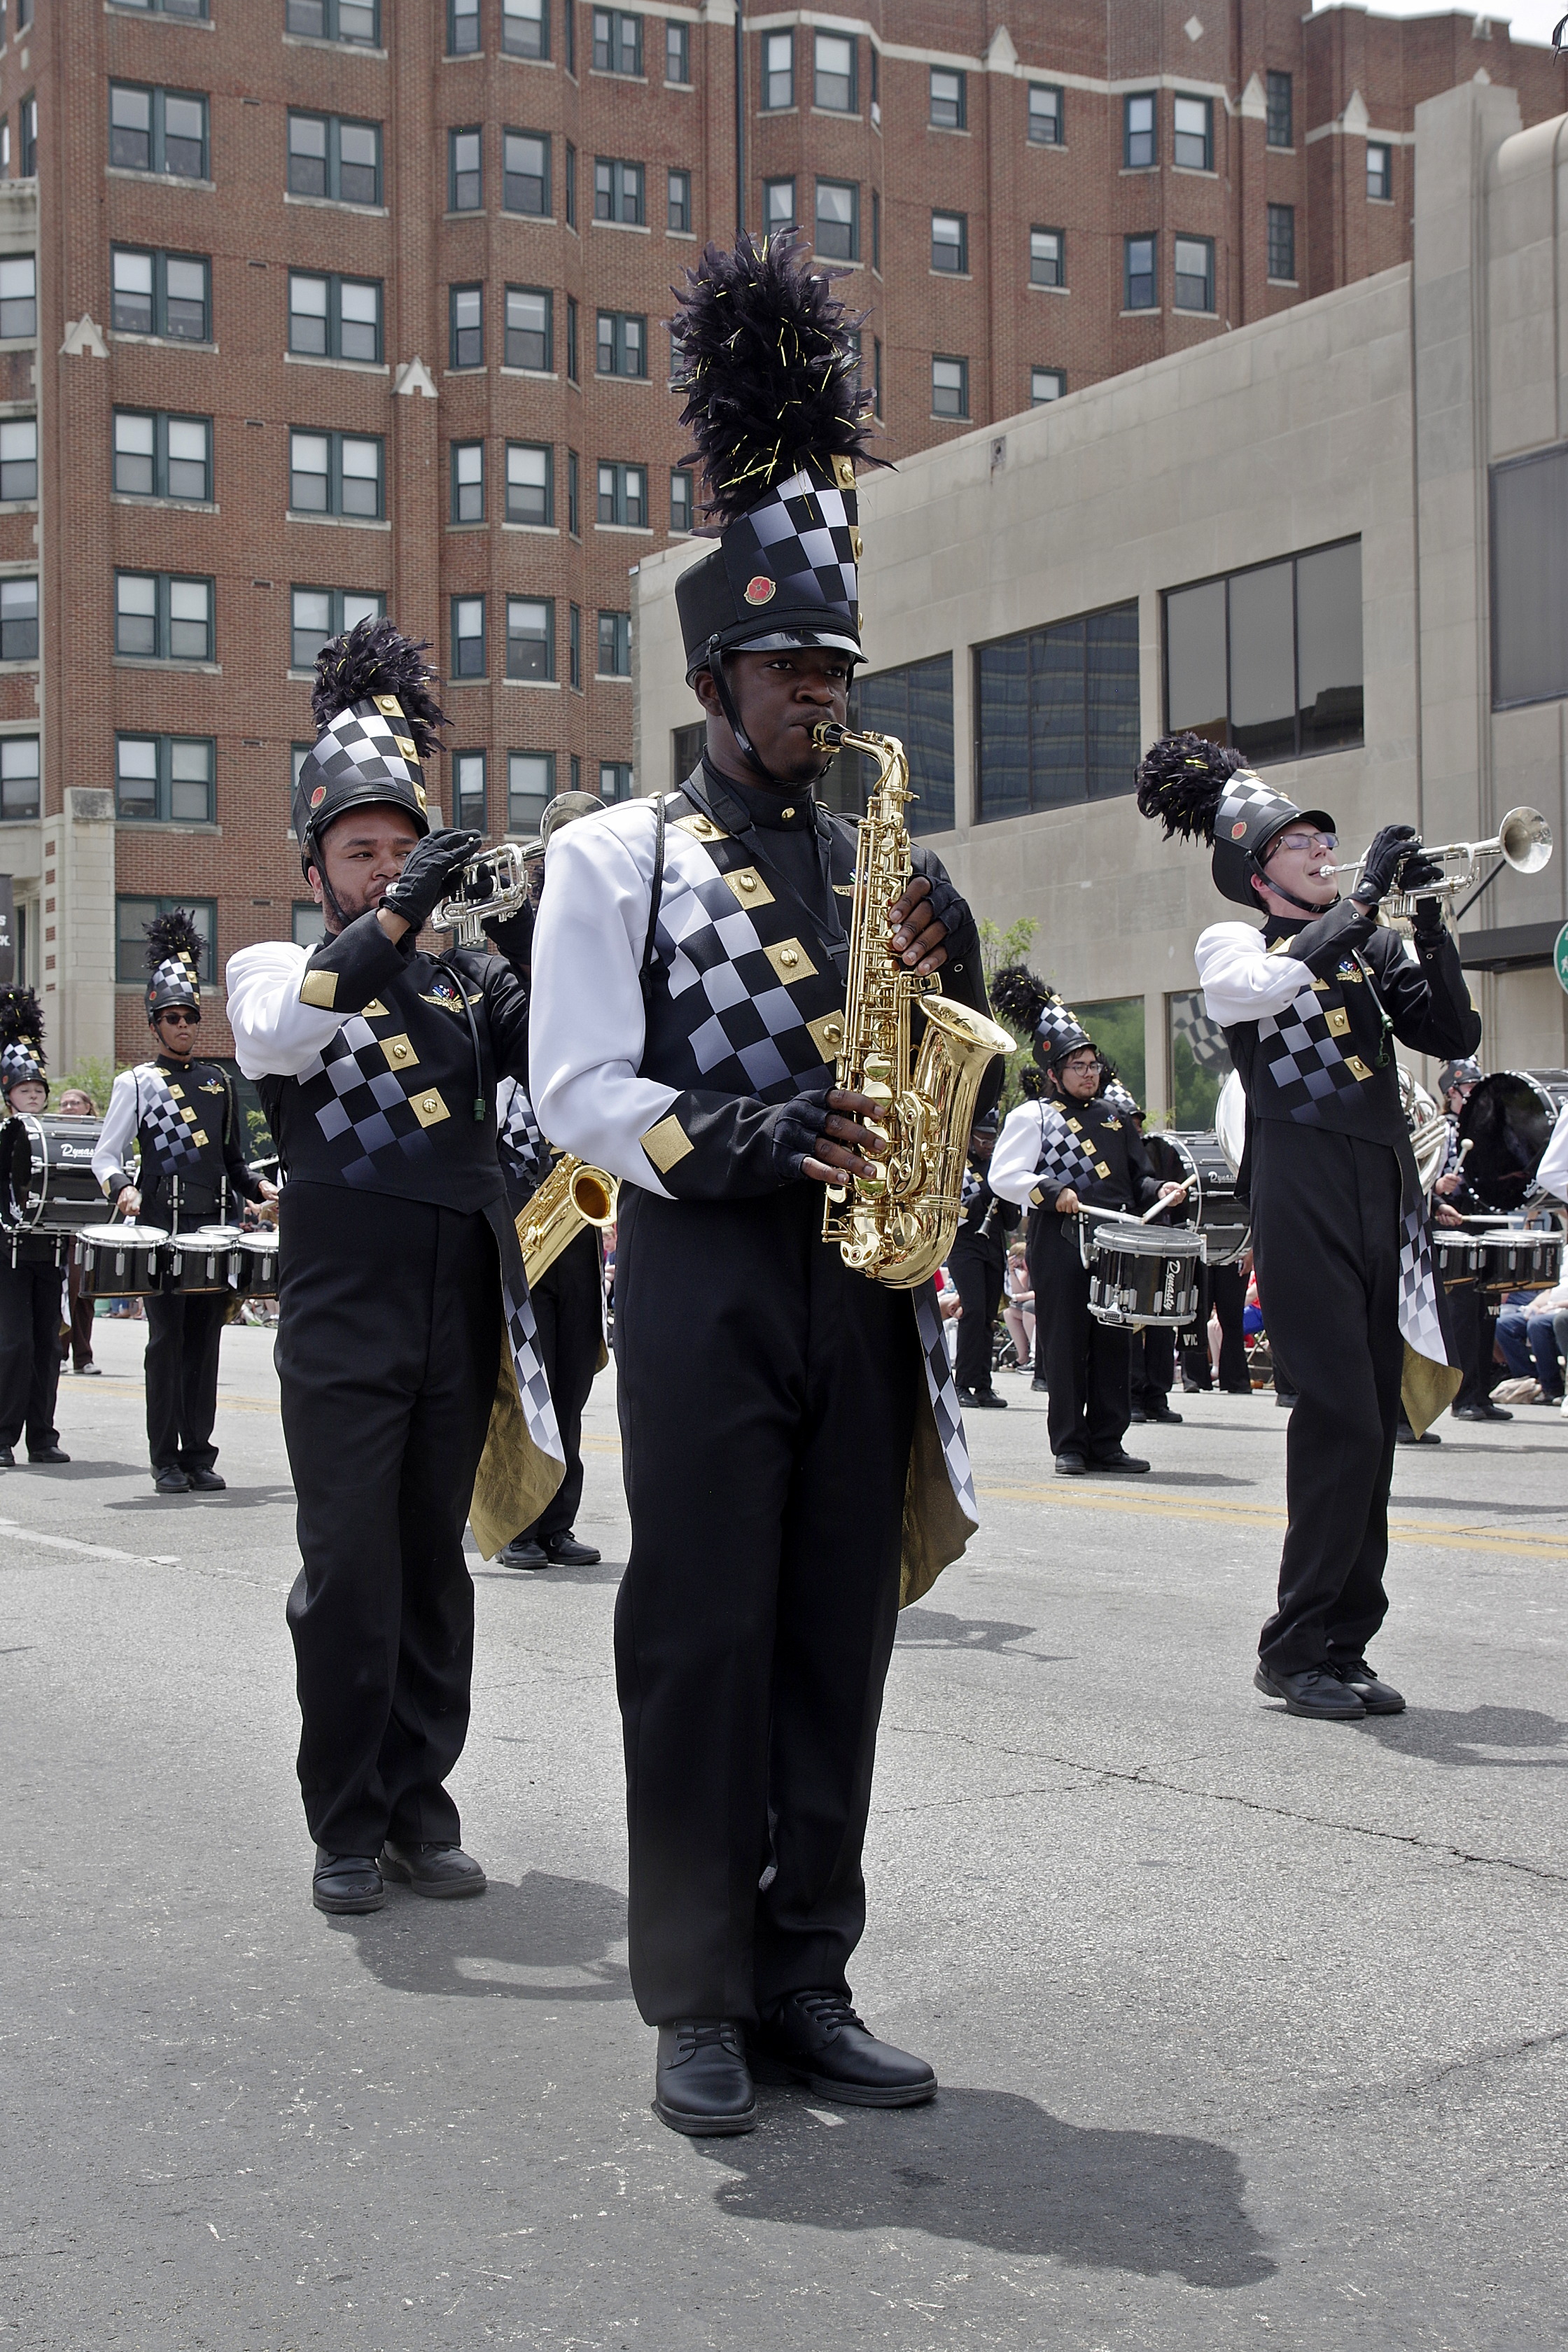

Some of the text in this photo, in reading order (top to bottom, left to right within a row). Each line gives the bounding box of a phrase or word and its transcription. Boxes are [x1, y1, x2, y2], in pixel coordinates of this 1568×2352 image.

[60, 1143, 94, 1158] Dynas
[1208, 1171, 1236, 1184] Dynas
[1163, 1260, 1180, 1310] Dynasty
[1183, 1334, 1198, 1346] VIC
